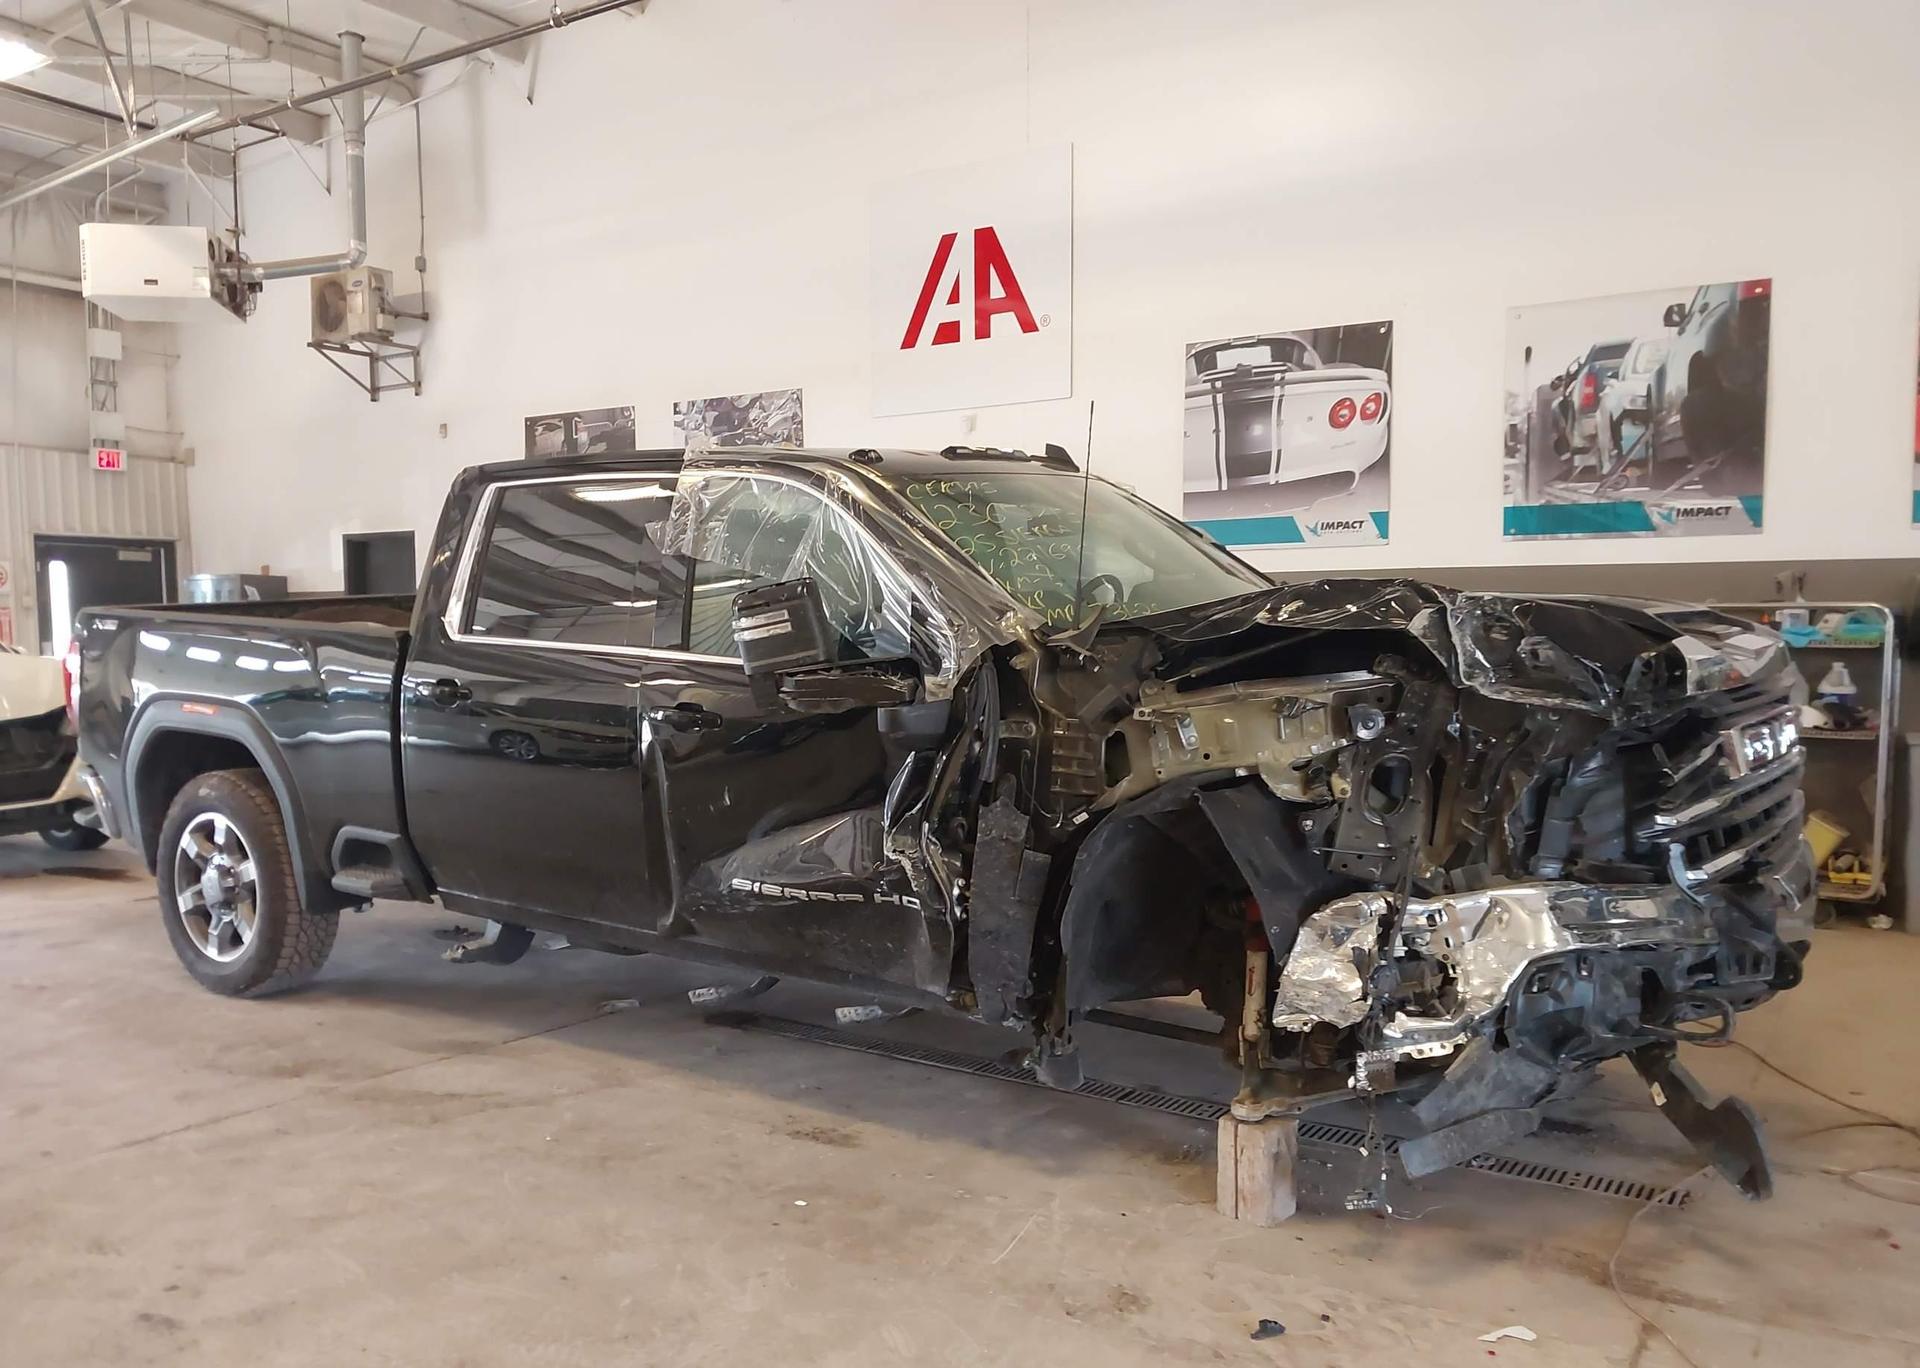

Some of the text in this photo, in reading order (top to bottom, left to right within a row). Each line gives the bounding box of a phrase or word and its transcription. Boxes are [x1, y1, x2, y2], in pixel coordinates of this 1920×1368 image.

[98, 450, 121, 469] EXIT
[1676, 506, 1732, 518] IMPACT
[1320, 520, 1365, 531] IMPACT
[731, 878, 864, 903] SIERRA
